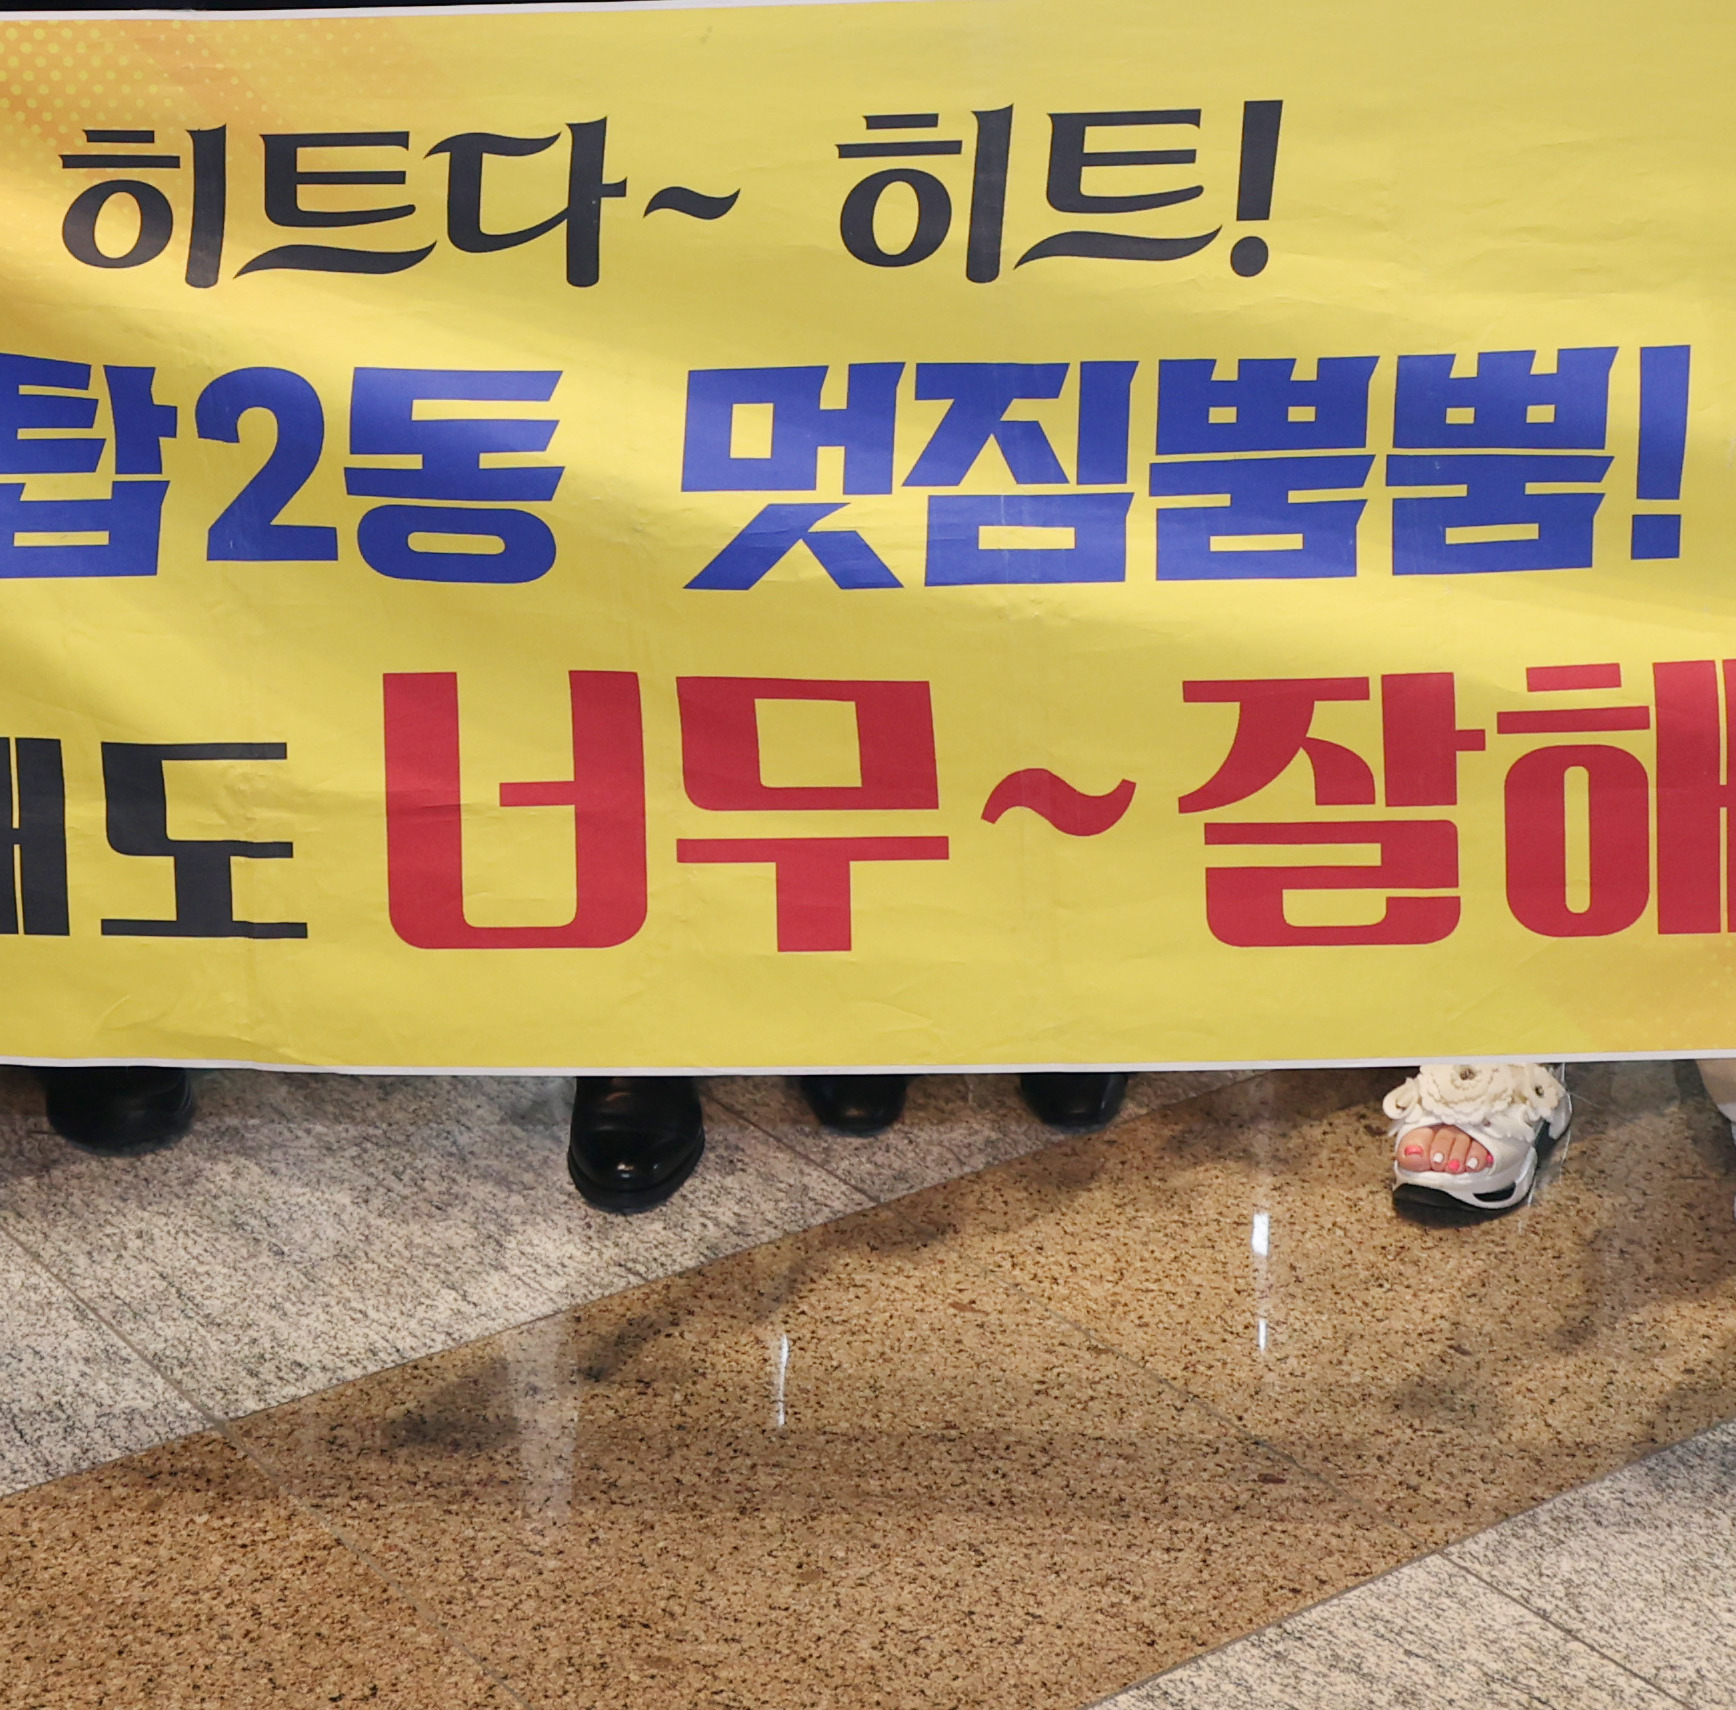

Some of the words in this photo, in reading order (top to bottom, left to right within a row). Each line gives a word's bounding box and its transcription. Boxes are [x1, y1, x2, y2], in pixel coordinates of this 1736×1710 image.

[58, 117, 741, 289] 히트다~
[836, 98, 1284, 284] 히트!
[682, 344, 1691, 591] 멋짐뿜뿜!
